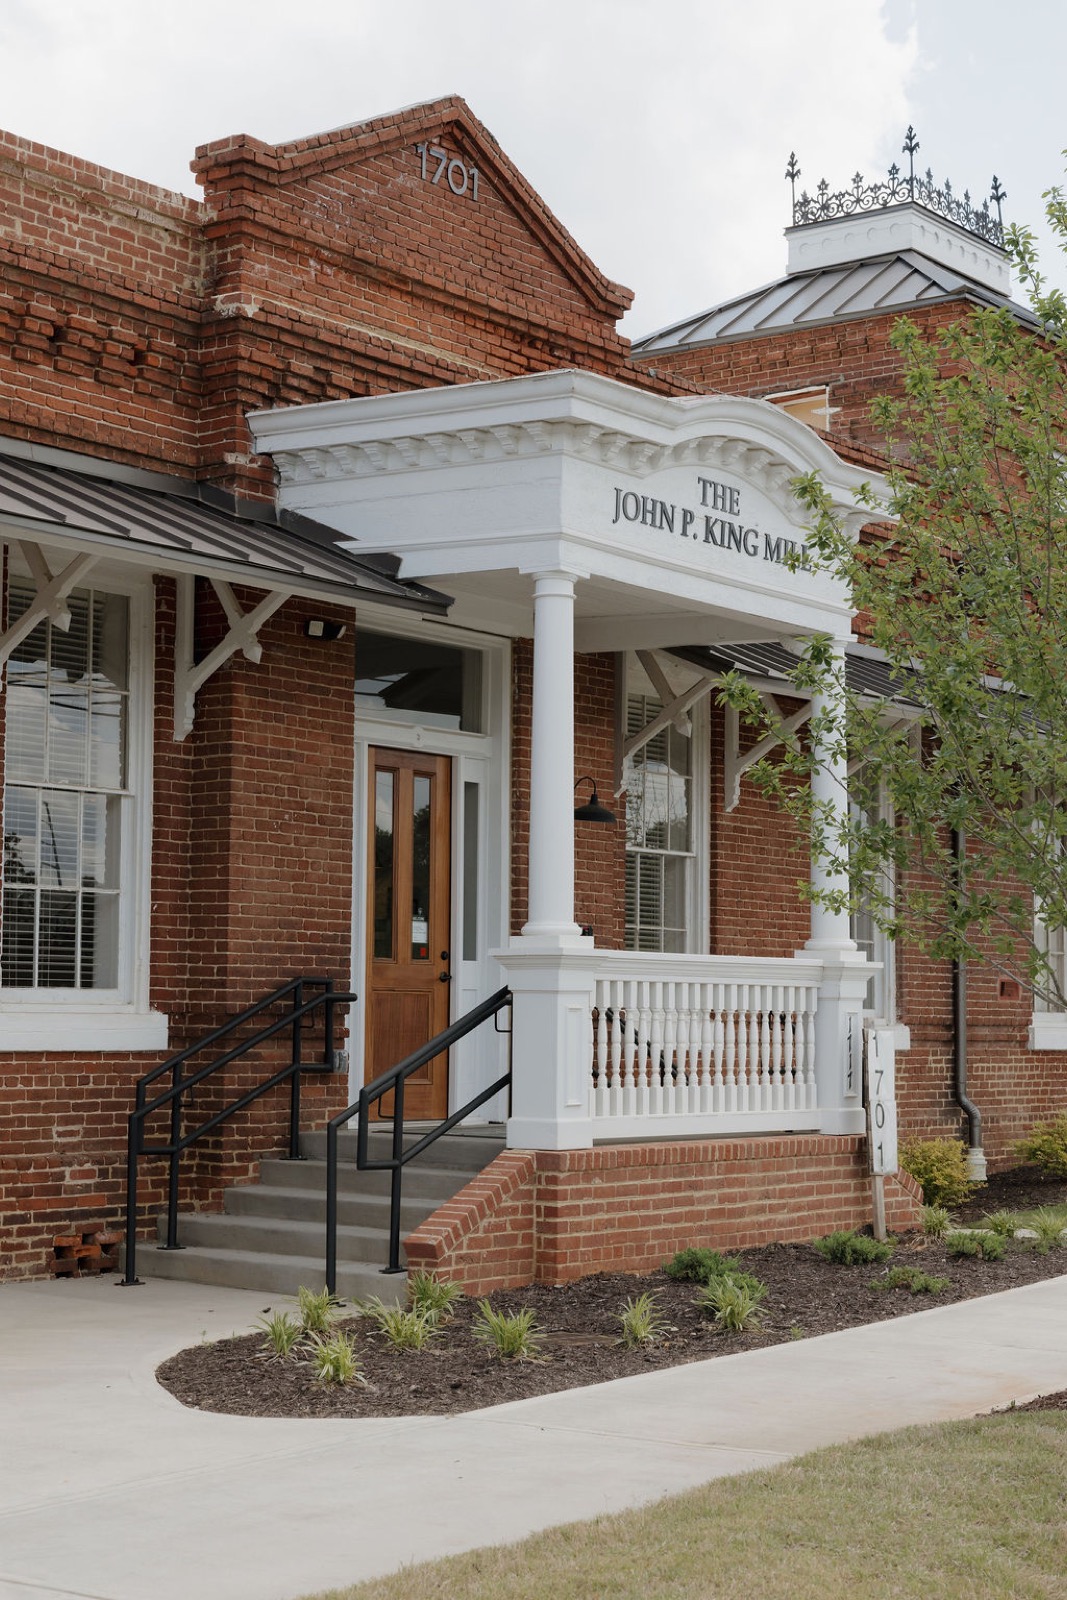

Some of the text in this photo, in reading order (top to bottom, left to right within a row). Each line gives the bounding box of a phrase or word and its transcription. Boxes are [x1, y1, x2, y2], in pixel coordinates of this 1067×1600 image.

[415, 141, 479, 201] 1701
[612, 487, 677, 534] JOHN
[680, 508, 698, 541] P.
[703, 515, 760, 558] KING
[697, 476, 741, 517] THE
[872, 1031, 886, 1168] 1701
